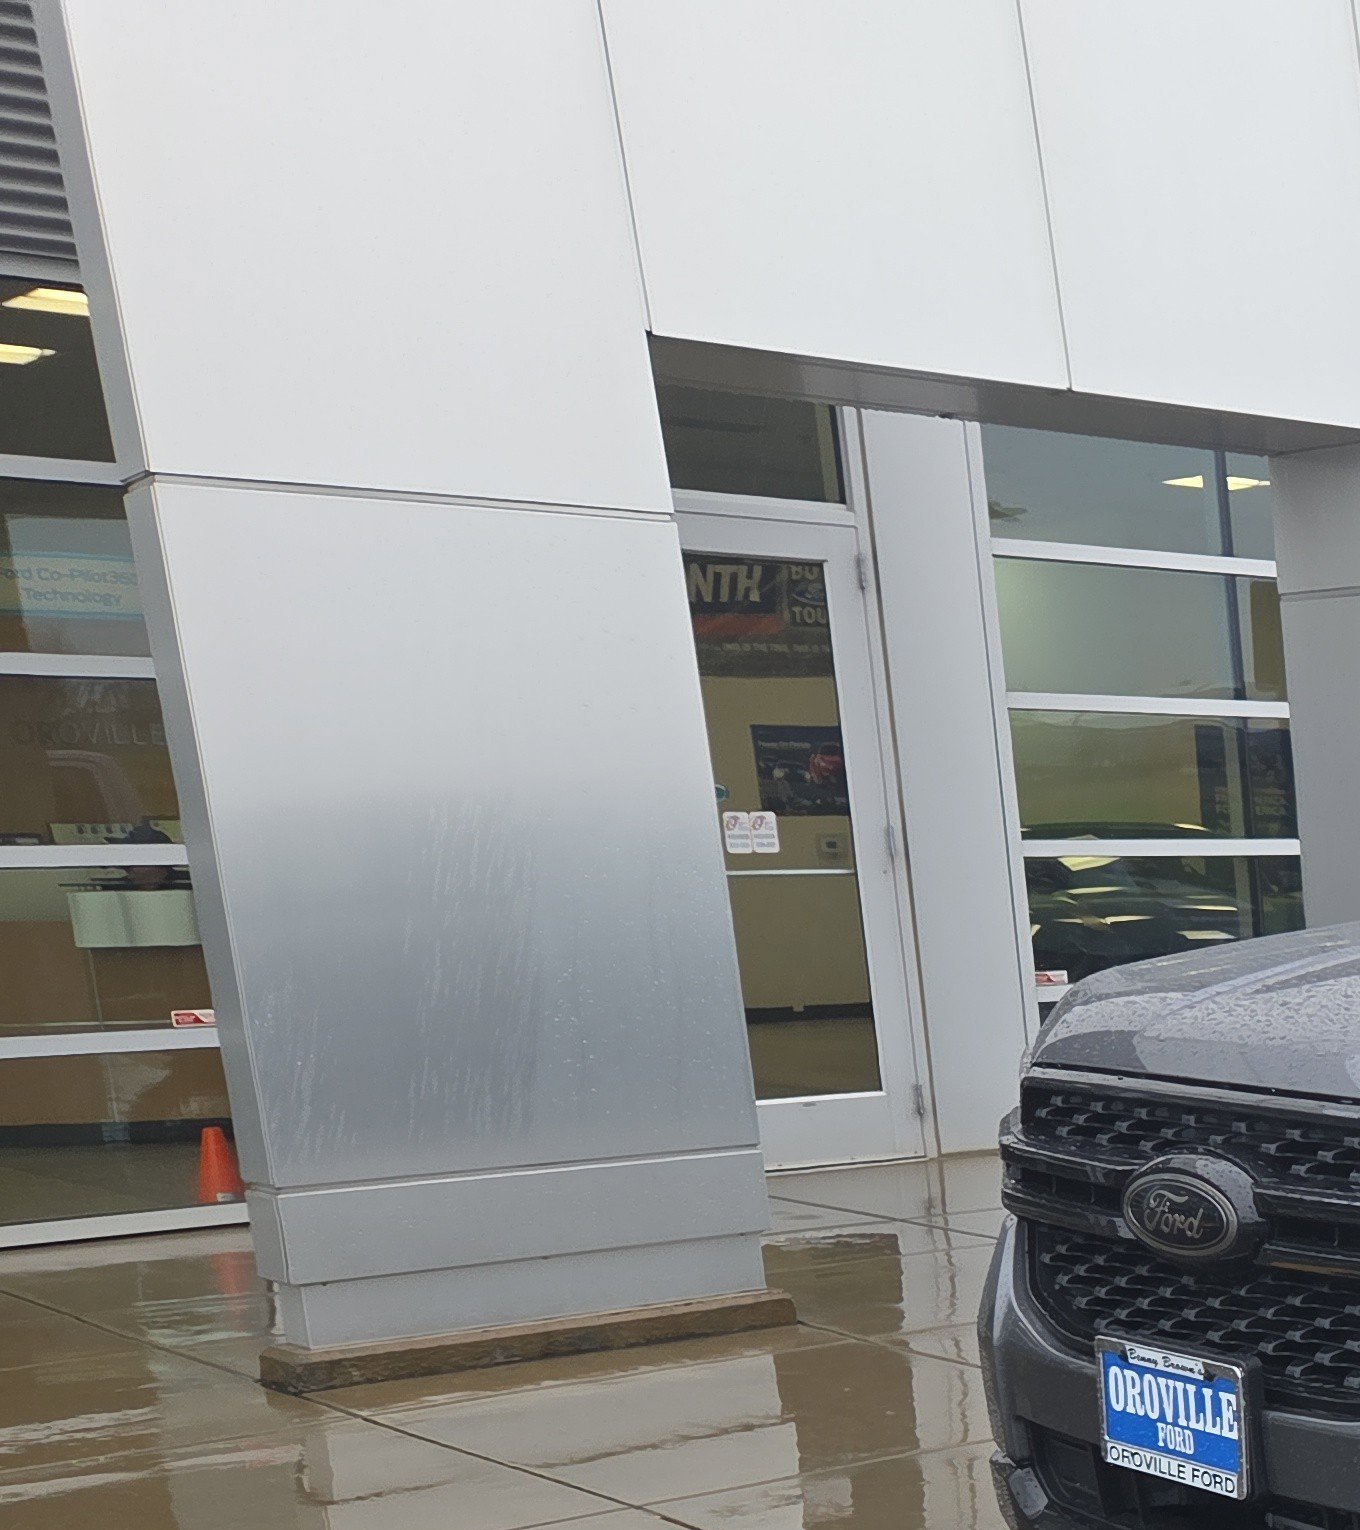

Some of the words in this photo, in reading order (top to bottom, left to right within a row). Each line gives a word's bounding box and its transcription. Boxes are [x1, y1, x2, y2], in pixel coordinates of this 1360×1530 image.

[20, 586, 121, 606] Technology
[1143, 1186, 1204, 1239] Ford
[1127, 1347, 1159, 1368] Benny
[1108, 1365, 1239, 1440] OROVILLE
[1156, 1422, 1195, 1455] FORD
[1109, 1445, 1187, 1481] OROVILLE
[1191, 1467, 1235, 1494] FORD
